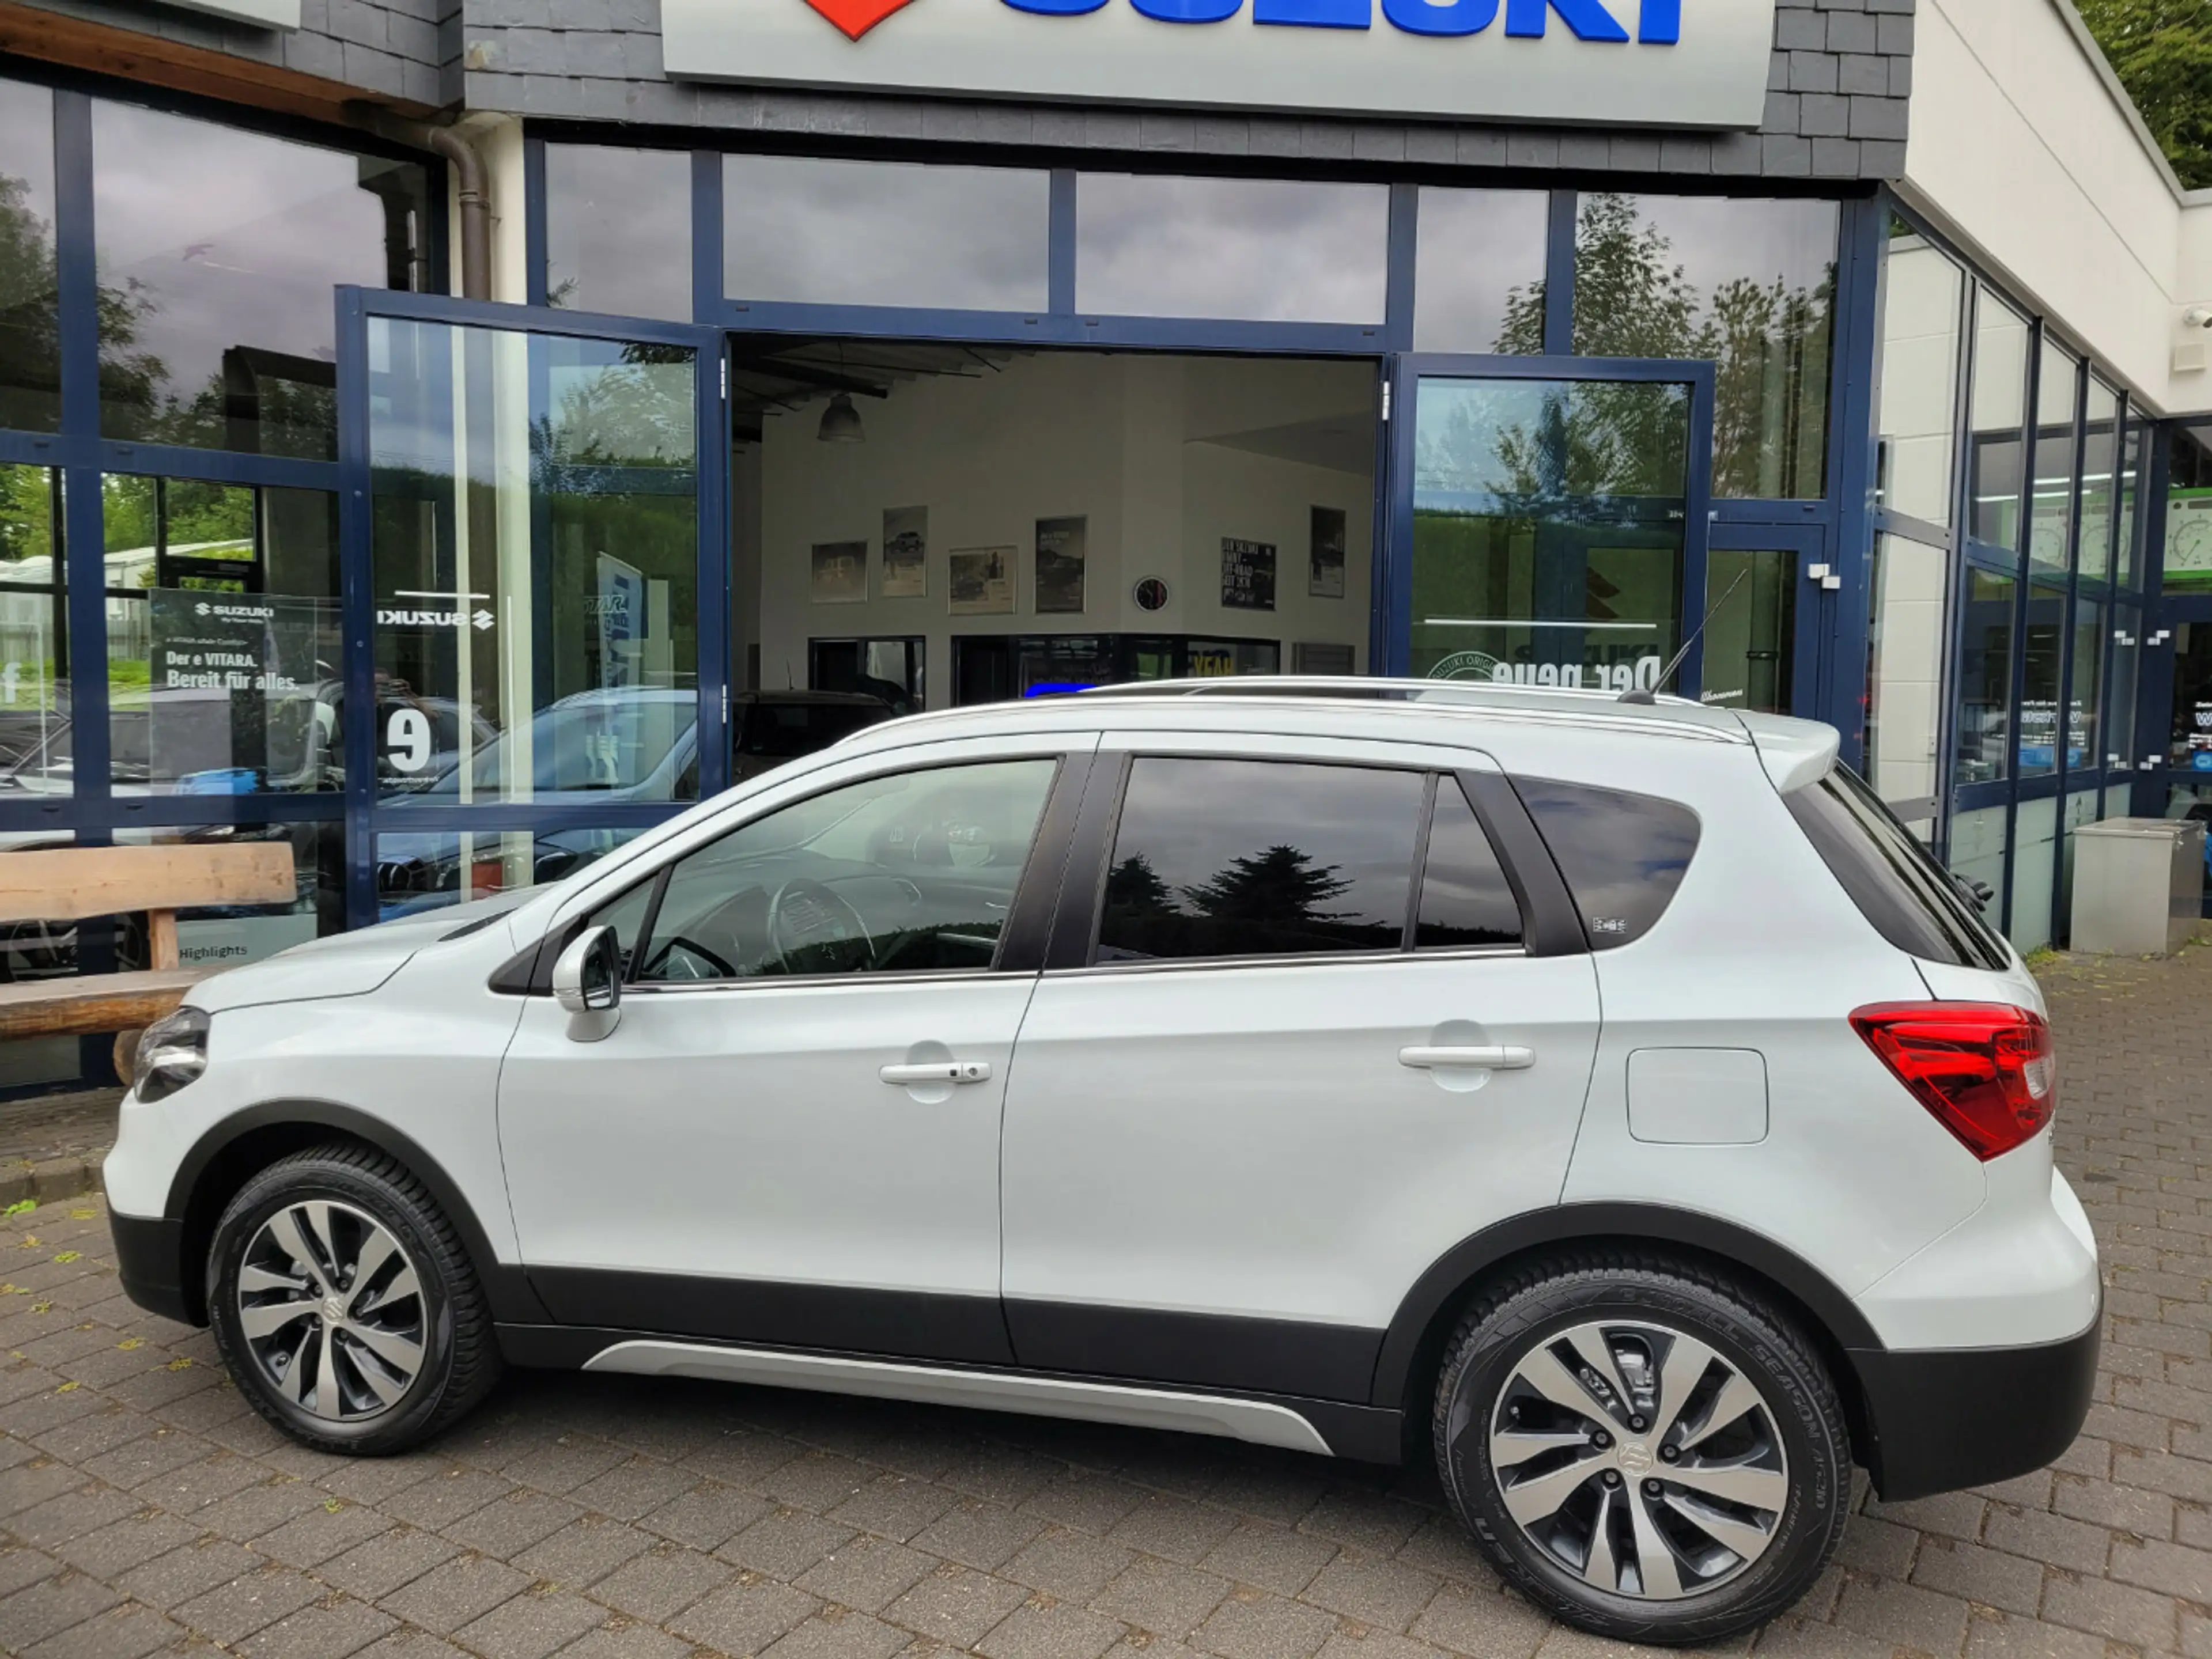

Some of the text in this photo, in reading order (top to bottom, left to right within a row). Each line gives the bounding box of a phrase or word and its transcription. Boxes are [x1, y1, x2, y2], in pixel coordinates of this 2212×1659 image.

[213, 605, 274, 617] SUZUKI
[166, 651, 259, 667] Der e VITARA.
[167, 669, 300, 690] Bereit für alles.
[179, 946, 248, 961] Highlights
